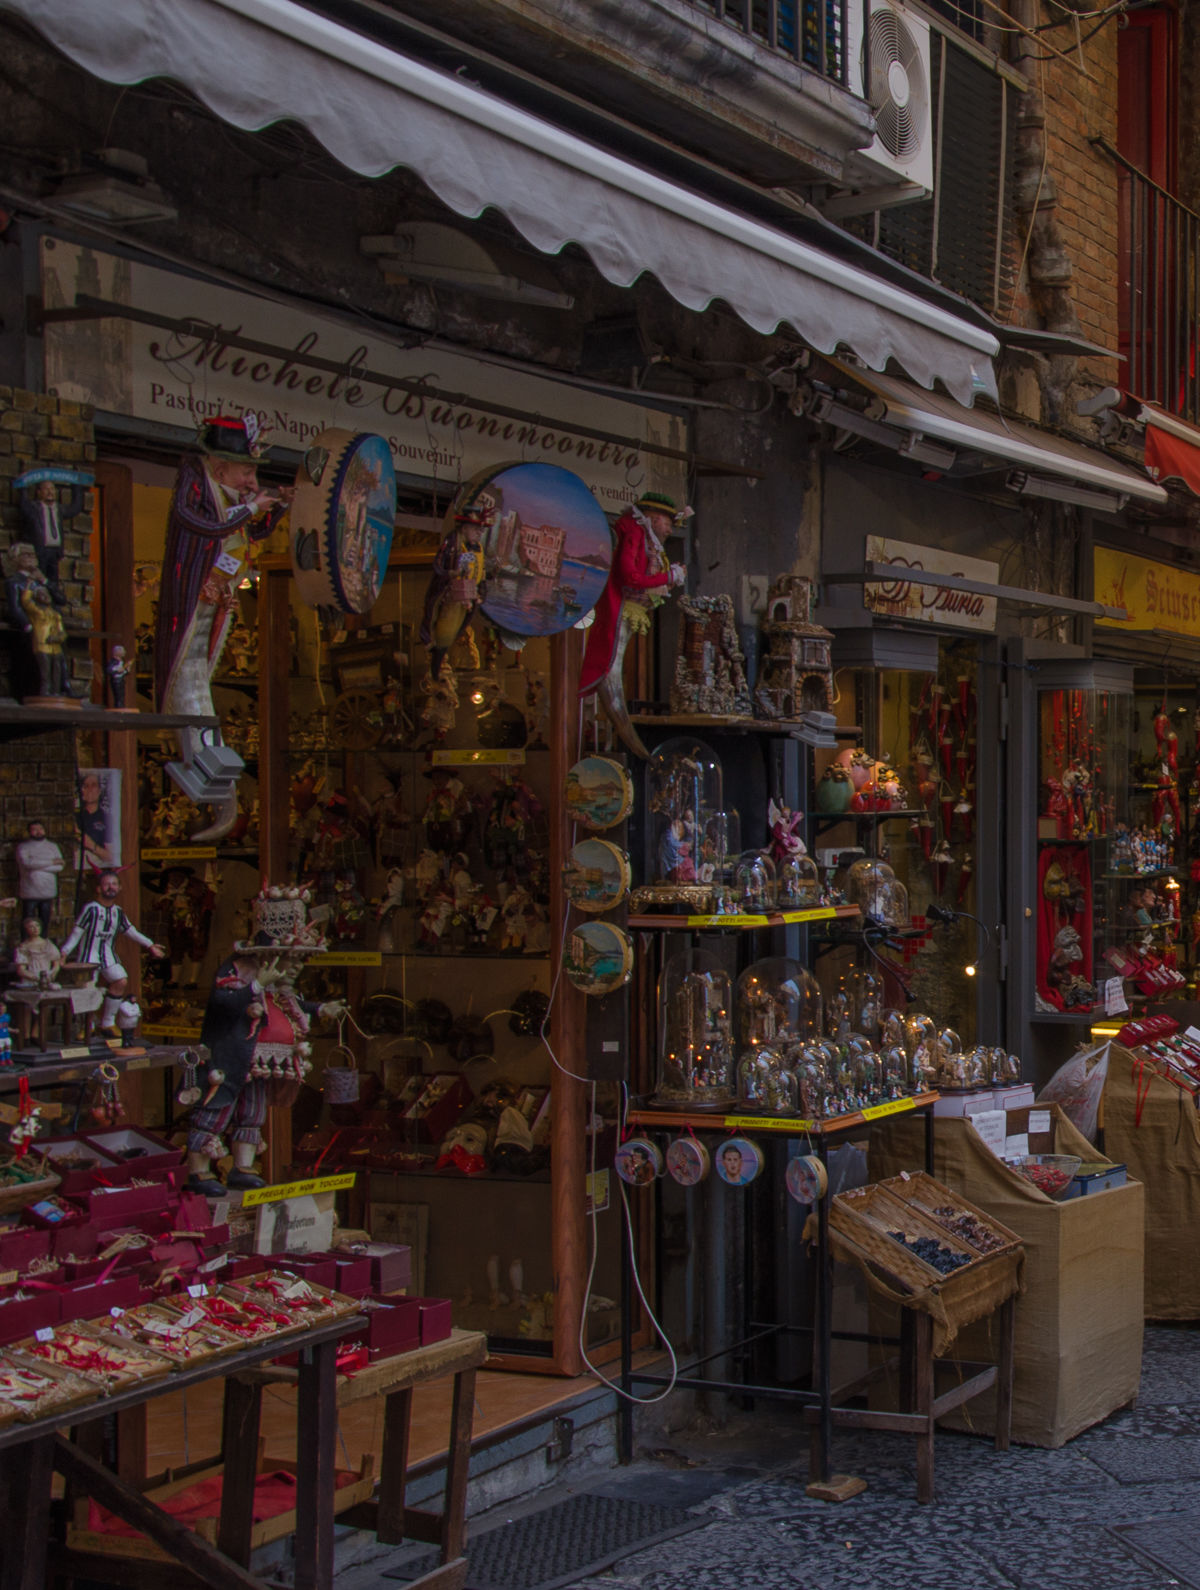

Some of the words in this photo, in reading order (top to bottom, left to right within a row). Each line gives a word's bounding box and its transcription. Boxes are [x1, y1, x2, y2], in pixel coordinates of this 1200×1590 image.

[149, 317, 366, 405] Michele
[382, 373, 640, 469] Buonincontro
[151, 382, 223, 417] Pastori
[258, 1188, 284, 1200] PREGA
[299, 1183, 316, 1193] NON
[319, 1176, 353, 1189] TOCCARE
